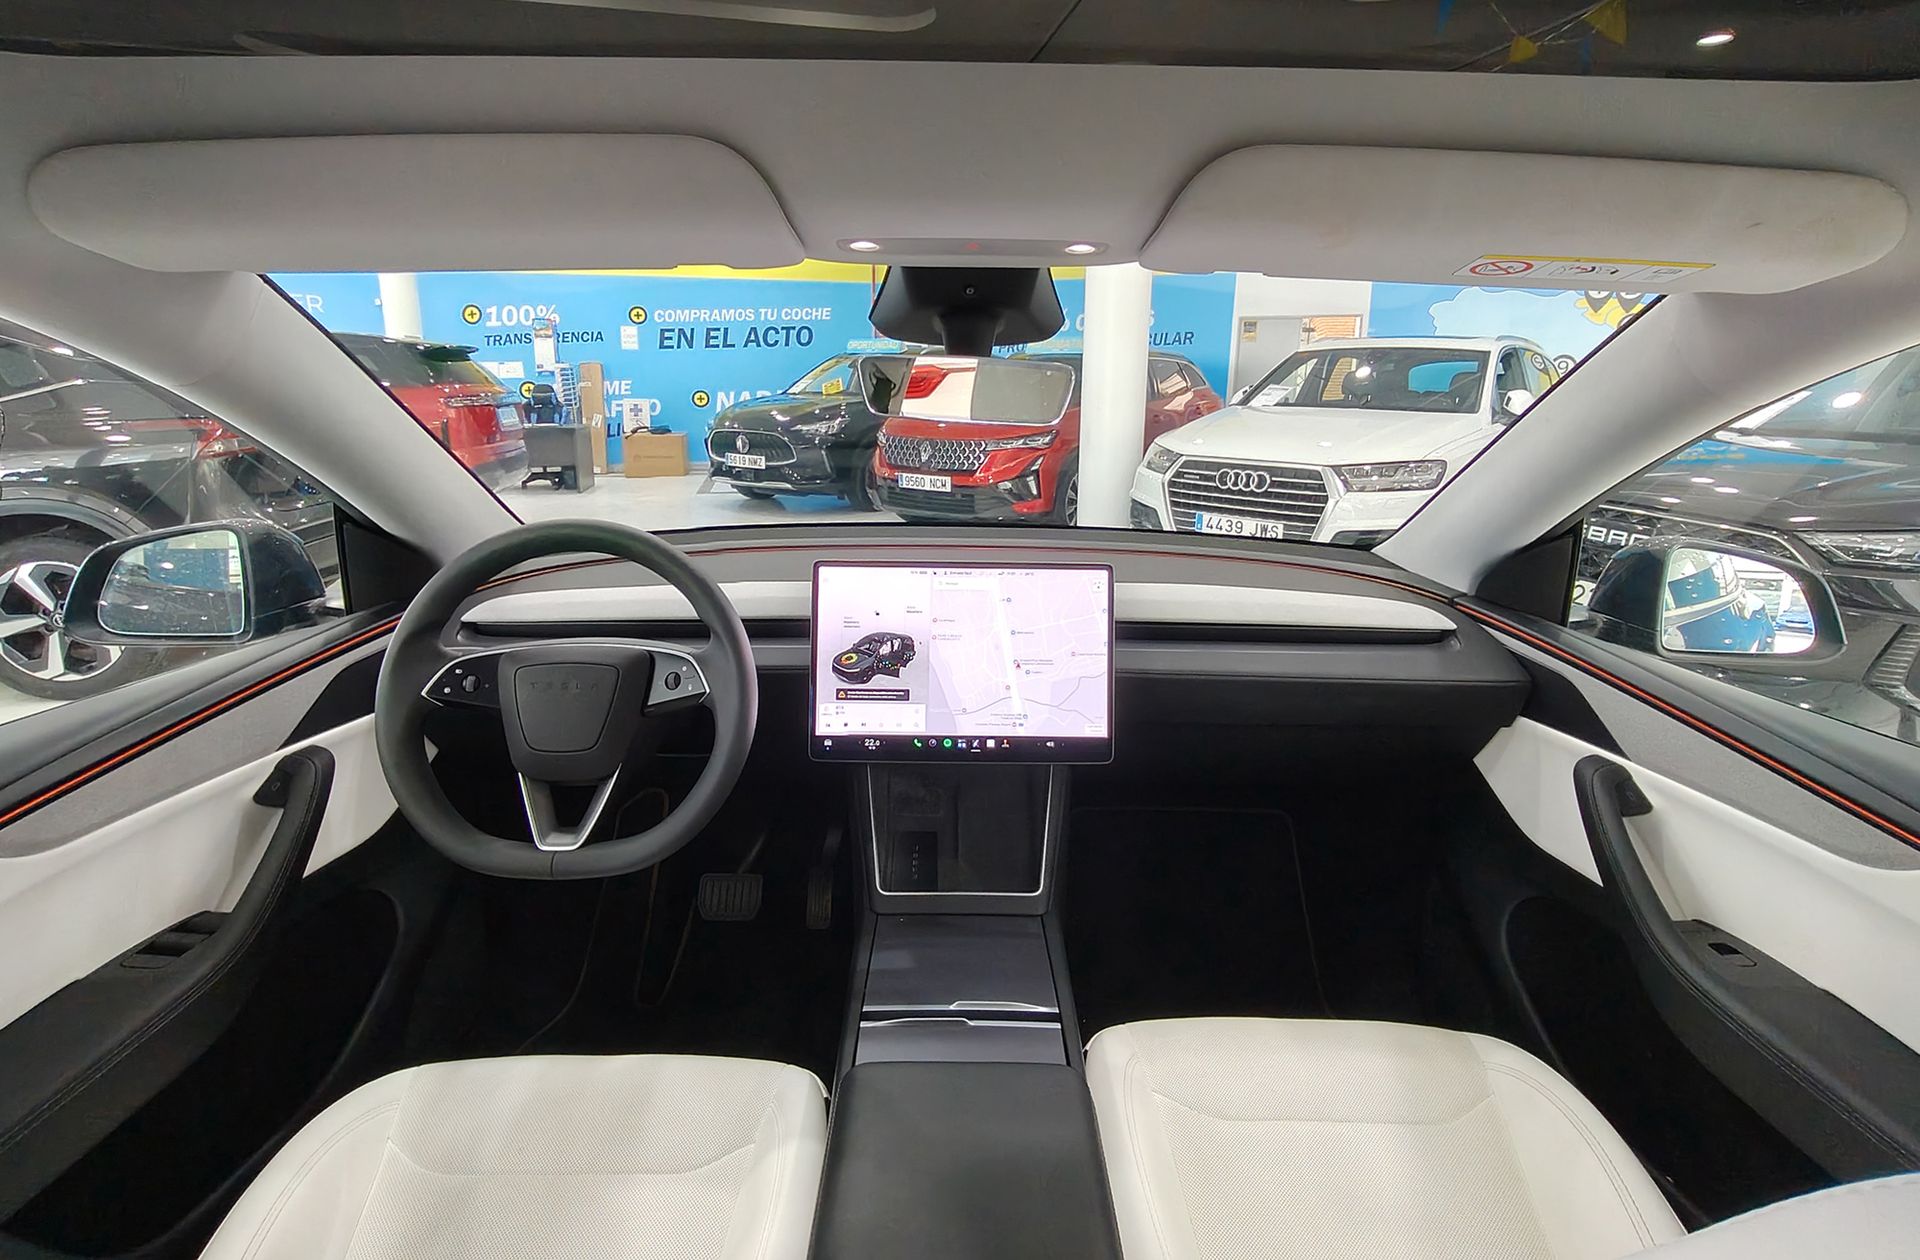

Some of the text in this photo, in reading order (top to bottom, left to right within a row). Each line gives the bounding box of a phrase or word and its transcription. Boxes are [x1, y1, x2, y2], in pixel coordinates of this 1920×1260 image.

[486, 304, 560, 326] 100%
[654, 307, 832, 323] COMPRAMOS TU COCHE
[484, 331, 604, 346] TRANSRENCIA
[658, 328, 695, 350] EN
[704, 327, 736, 349] EL
[743, 326, 814, 348] ACTO
[905, 475, 926, 488] 9560
[1206, 516, 1279, 539] 4439 JWS
[864, 738, 881, 747] 22.0
